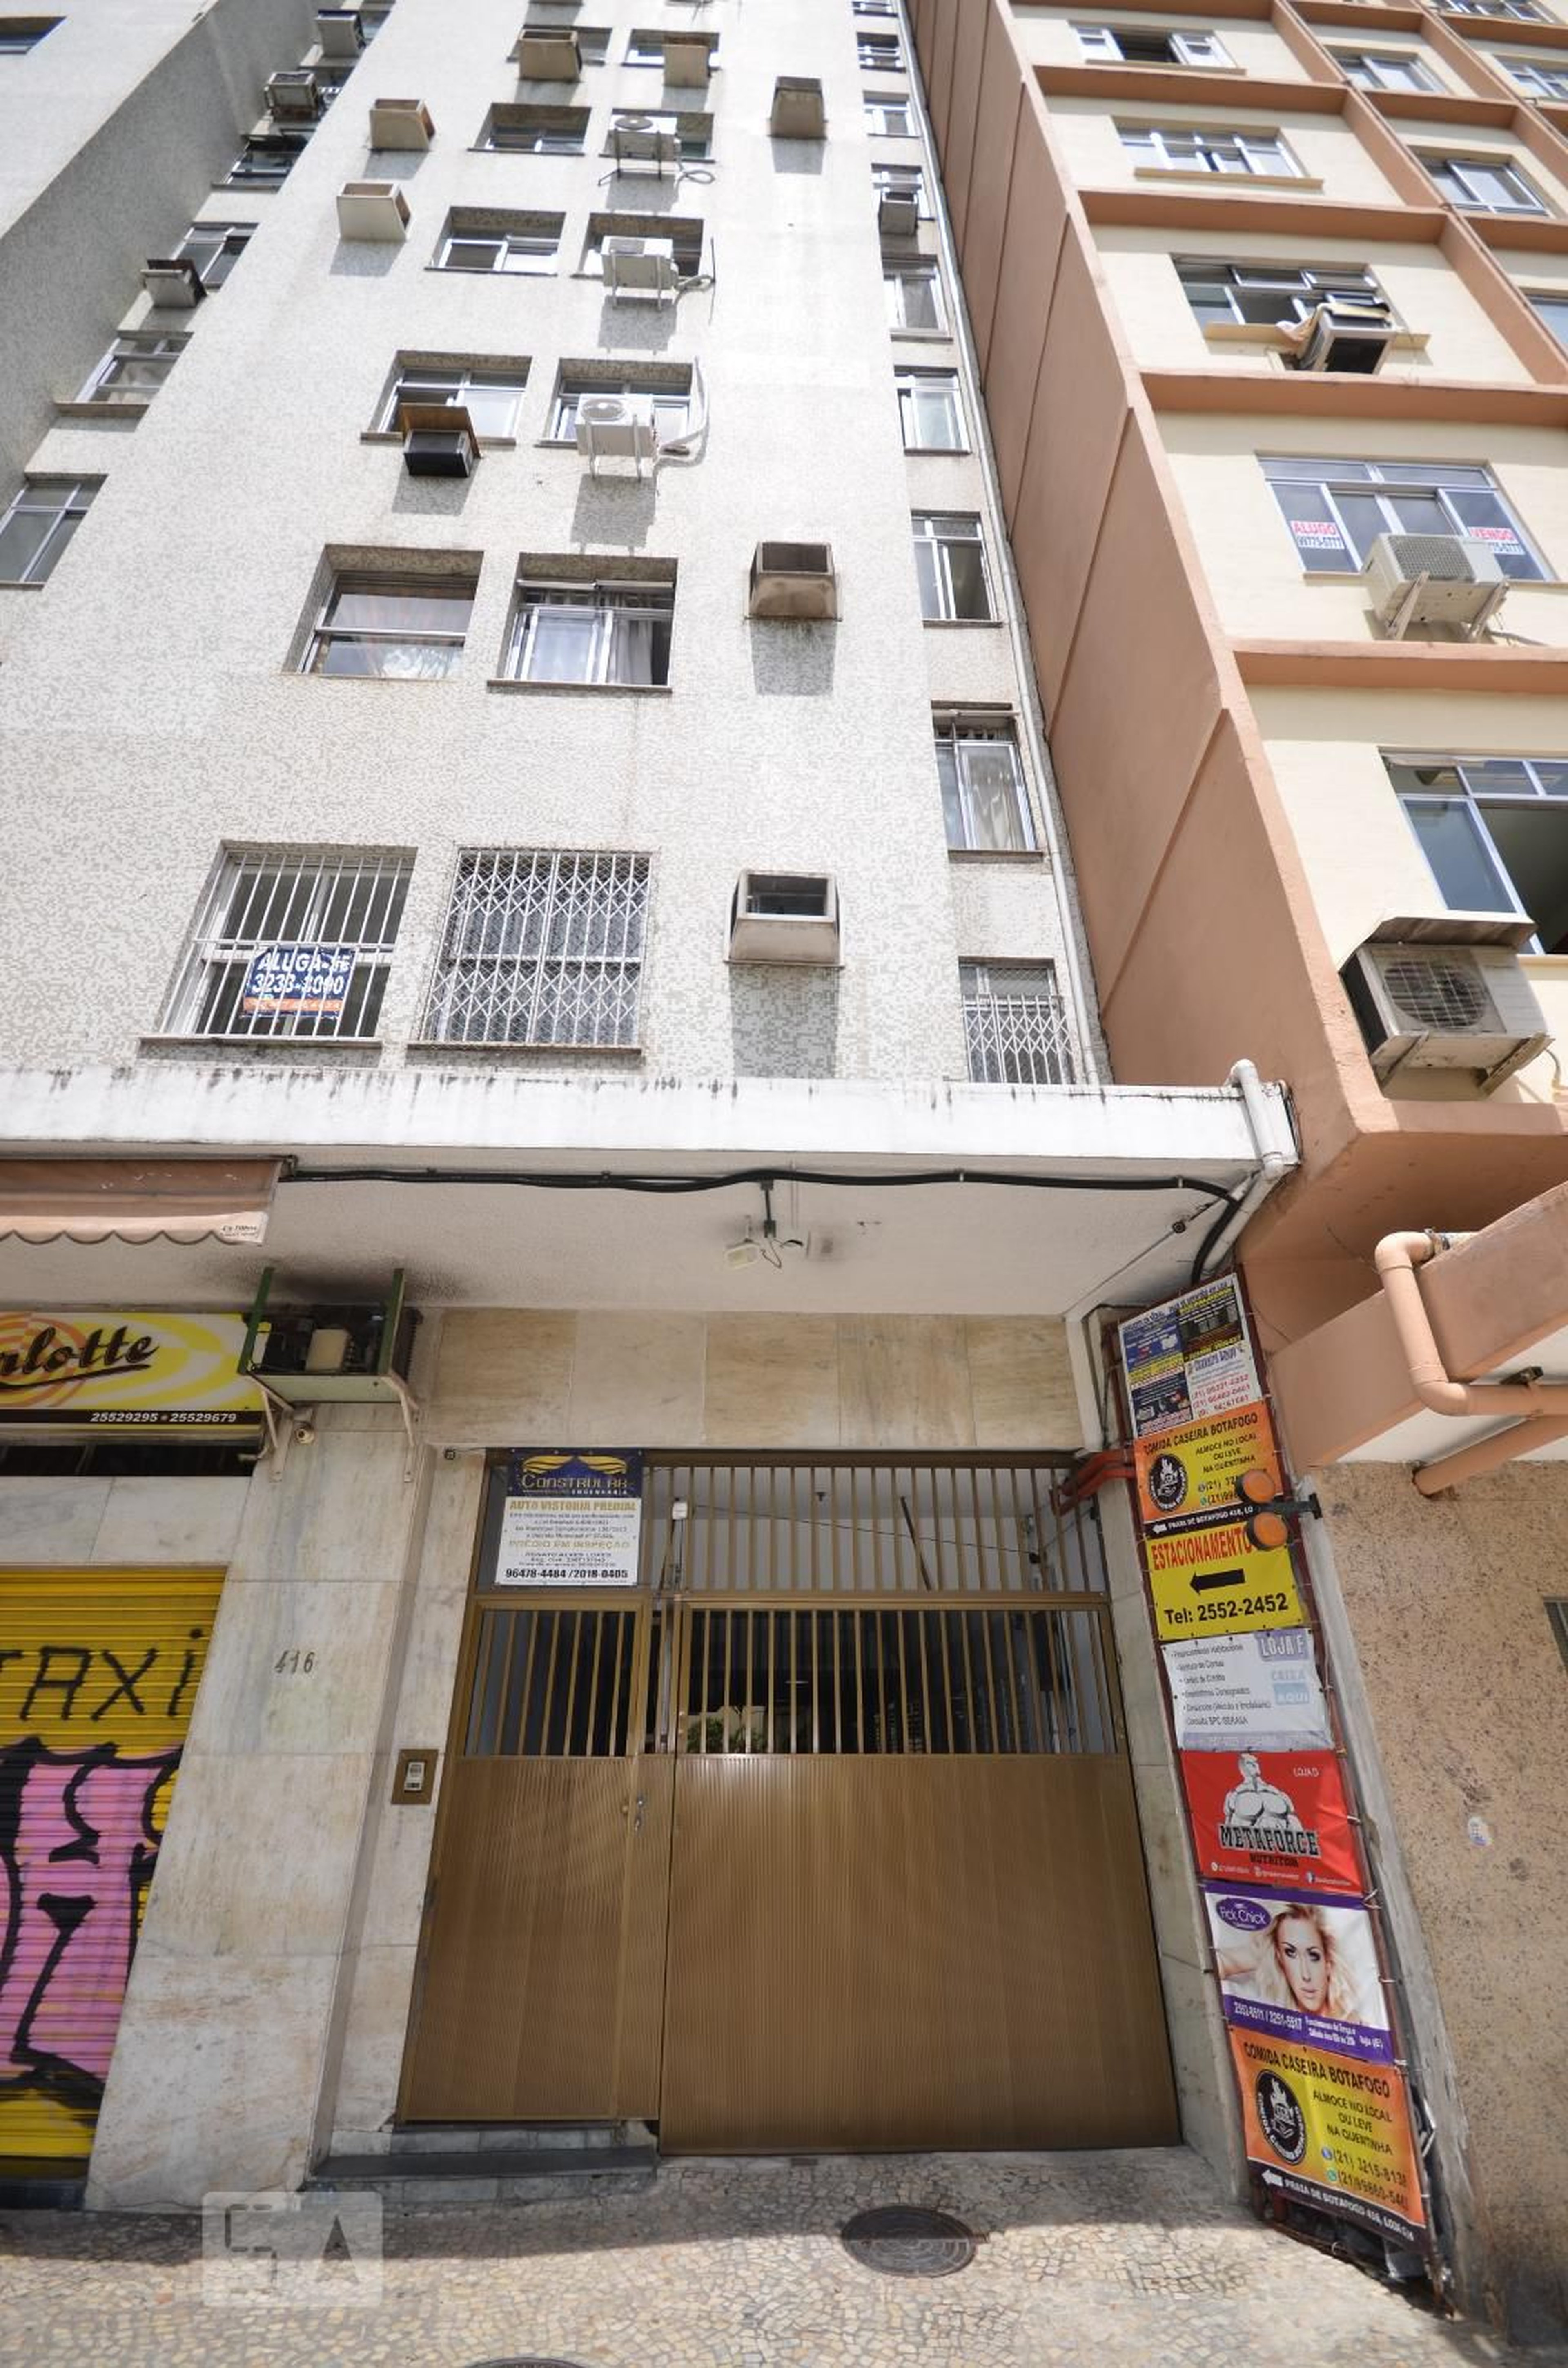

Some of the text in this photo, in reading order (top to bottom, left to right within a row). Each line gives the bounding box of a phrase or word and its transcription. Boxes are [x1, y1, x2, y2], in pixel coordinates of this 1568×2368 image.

[1294, 522, 1336, 535] ALUGO
[1471, 528, 1515, 540] VENDO
[90, 1413, 236, 1423] 25529295 25529679
[1174, 1427, 1208, 1446] CASEIRA
[1211, 1413, 1258, 1436] BOTAFOGO
[510, 1501, 637, 1511] AUTO VISTORIA PREDIAL
[1151, 1526, 1252, 1571] ESTACIONAMENTO
[1164, 1593, 1288, 1625] Tel: 2552-2452
[1261, 1635, 1294, 1655] LOJA
[274, 1650, 315, 1673] 416
[1220, 1825, 1319, 1855] METAFORCE
[1244, 2043, 1390, 2098] COMIDA CASEIRA BOTAFOGO
[1314, 2090, 1348, 2109] ALMOCE
[1365, 2105, 1392, 2122] LOCAL
[1338, 2113, 1372, 2132] OU LEVE
[1327, 2124, 1393, 2156] NA QUENTINHA
